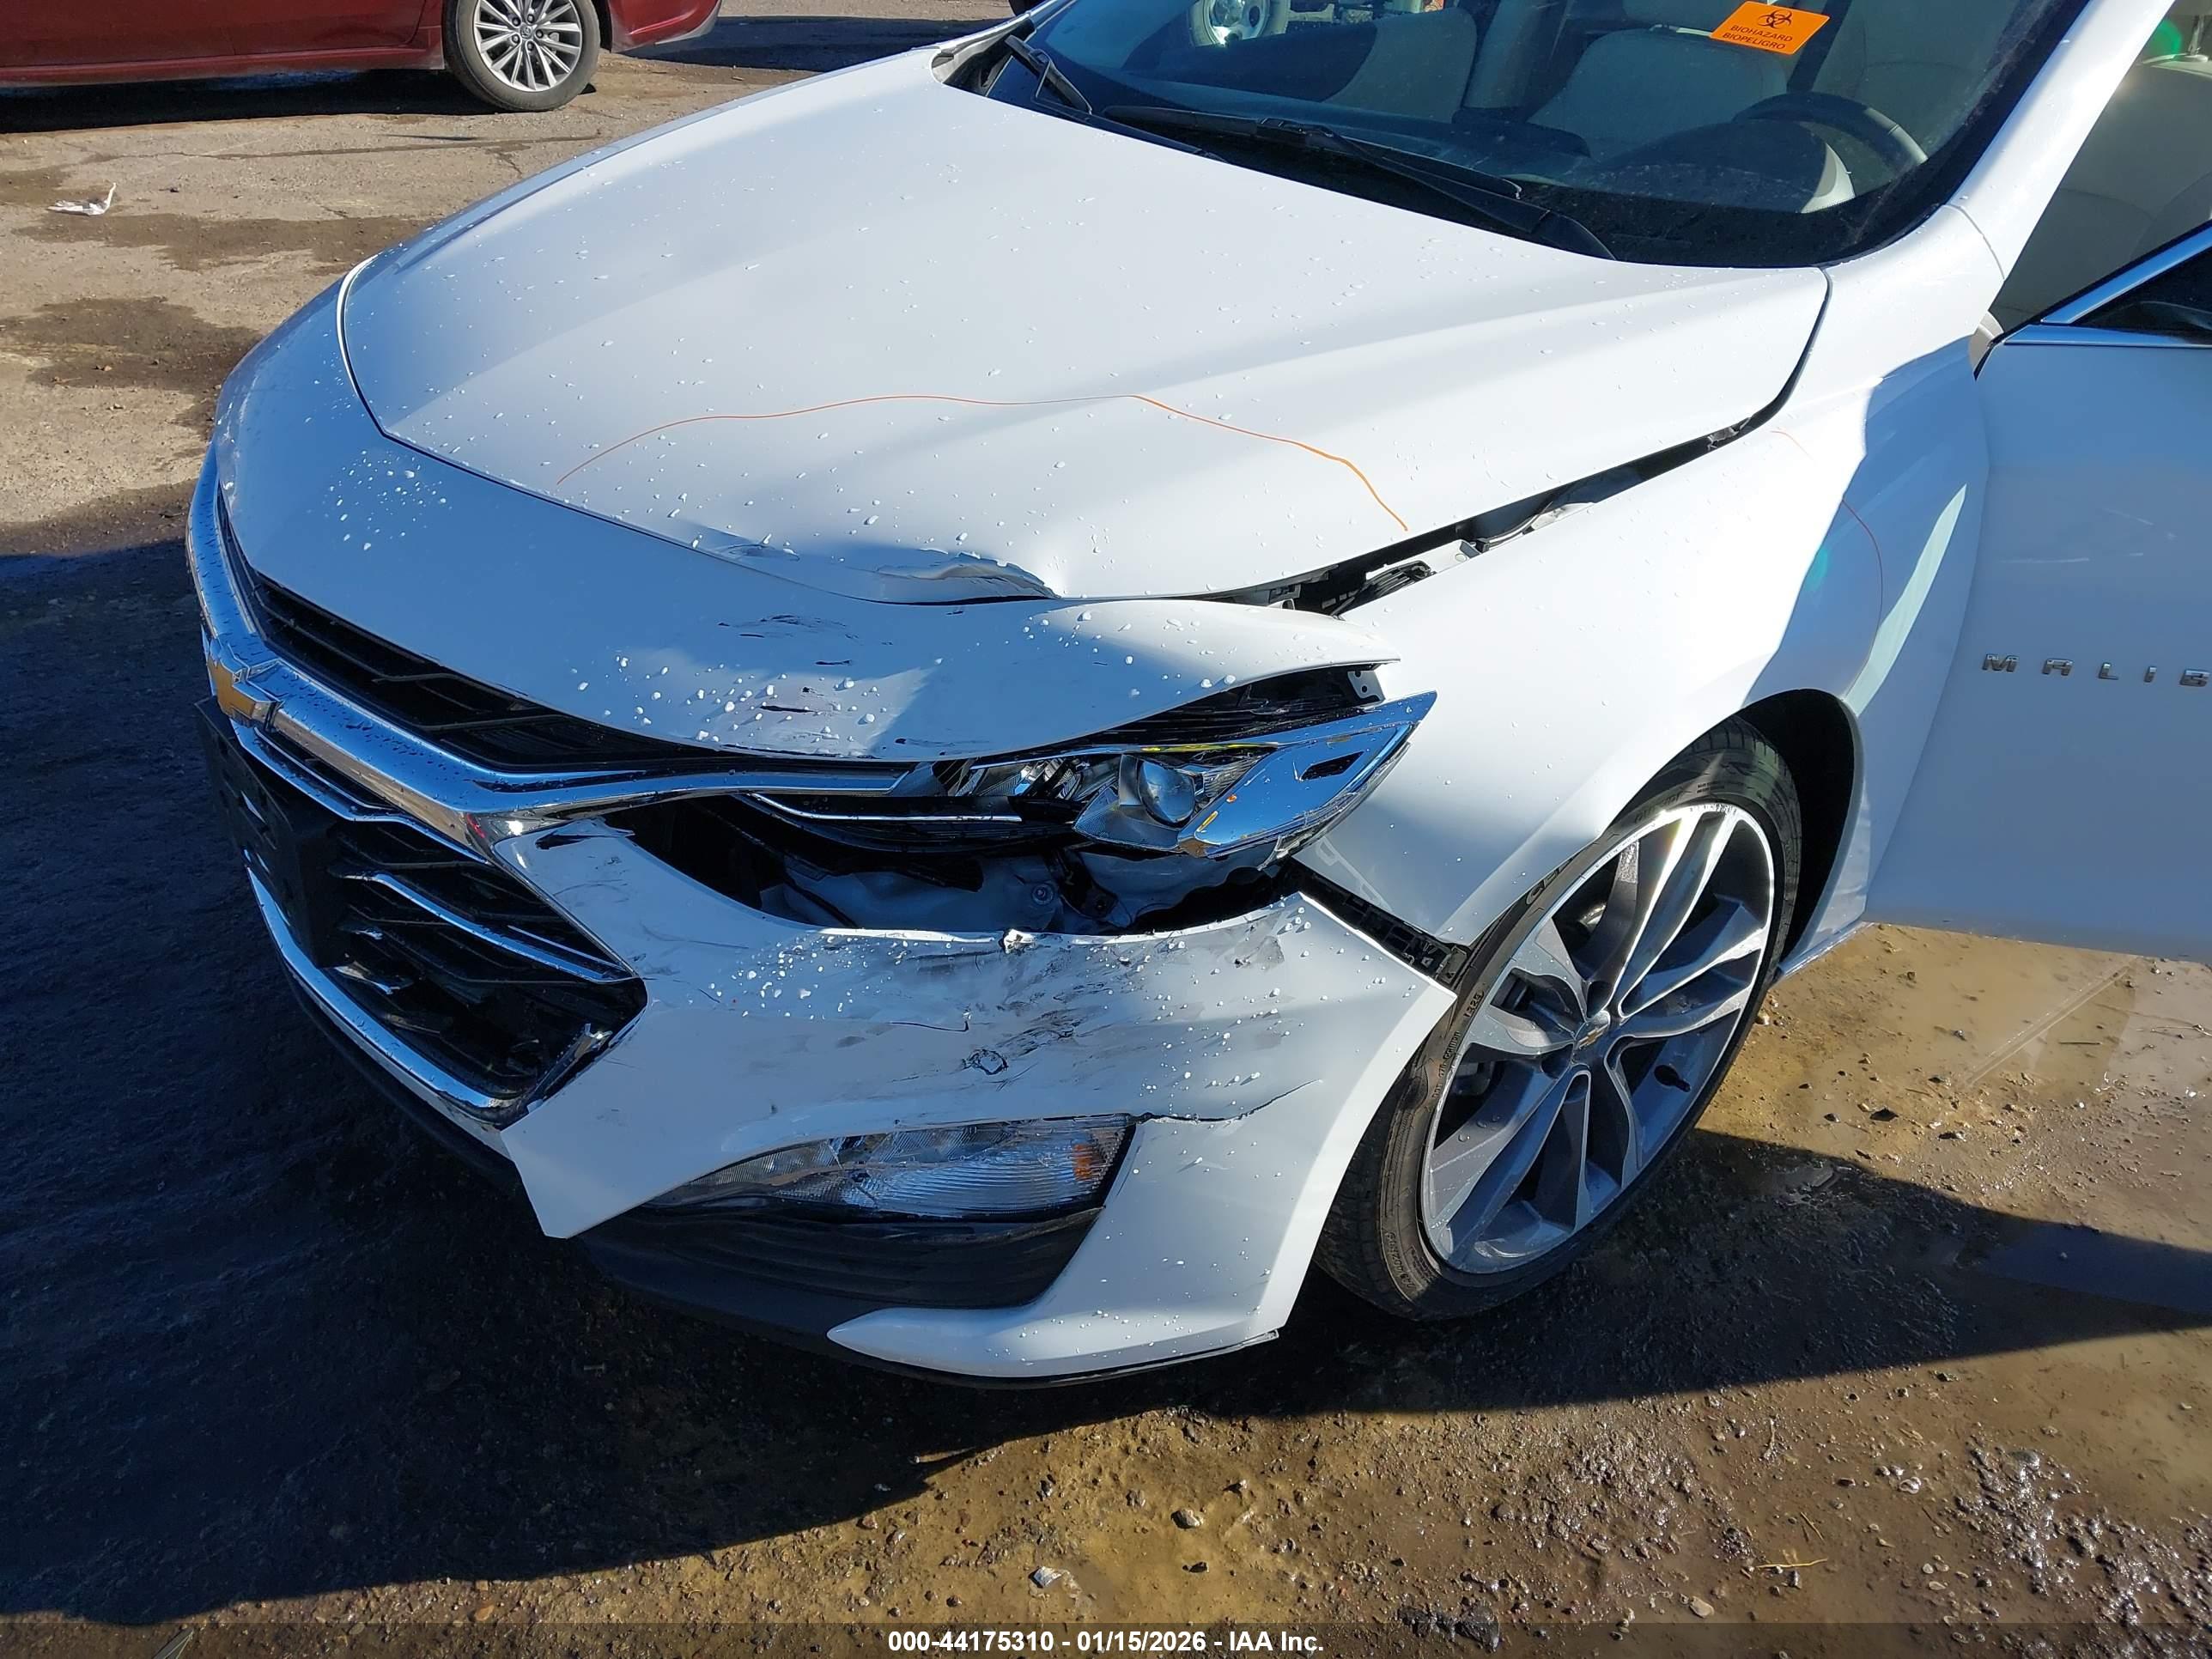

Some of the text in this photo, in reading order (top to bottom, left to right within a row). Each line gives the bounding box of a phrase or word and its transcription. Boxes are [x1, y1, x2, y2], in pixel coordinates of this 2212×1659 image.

[1723, 32, 1786, 50] BIOPELIGRO
[1729, 25, 1793, 42] BIOHAZARD
[1982, 653, 2211, 687] MALIB
